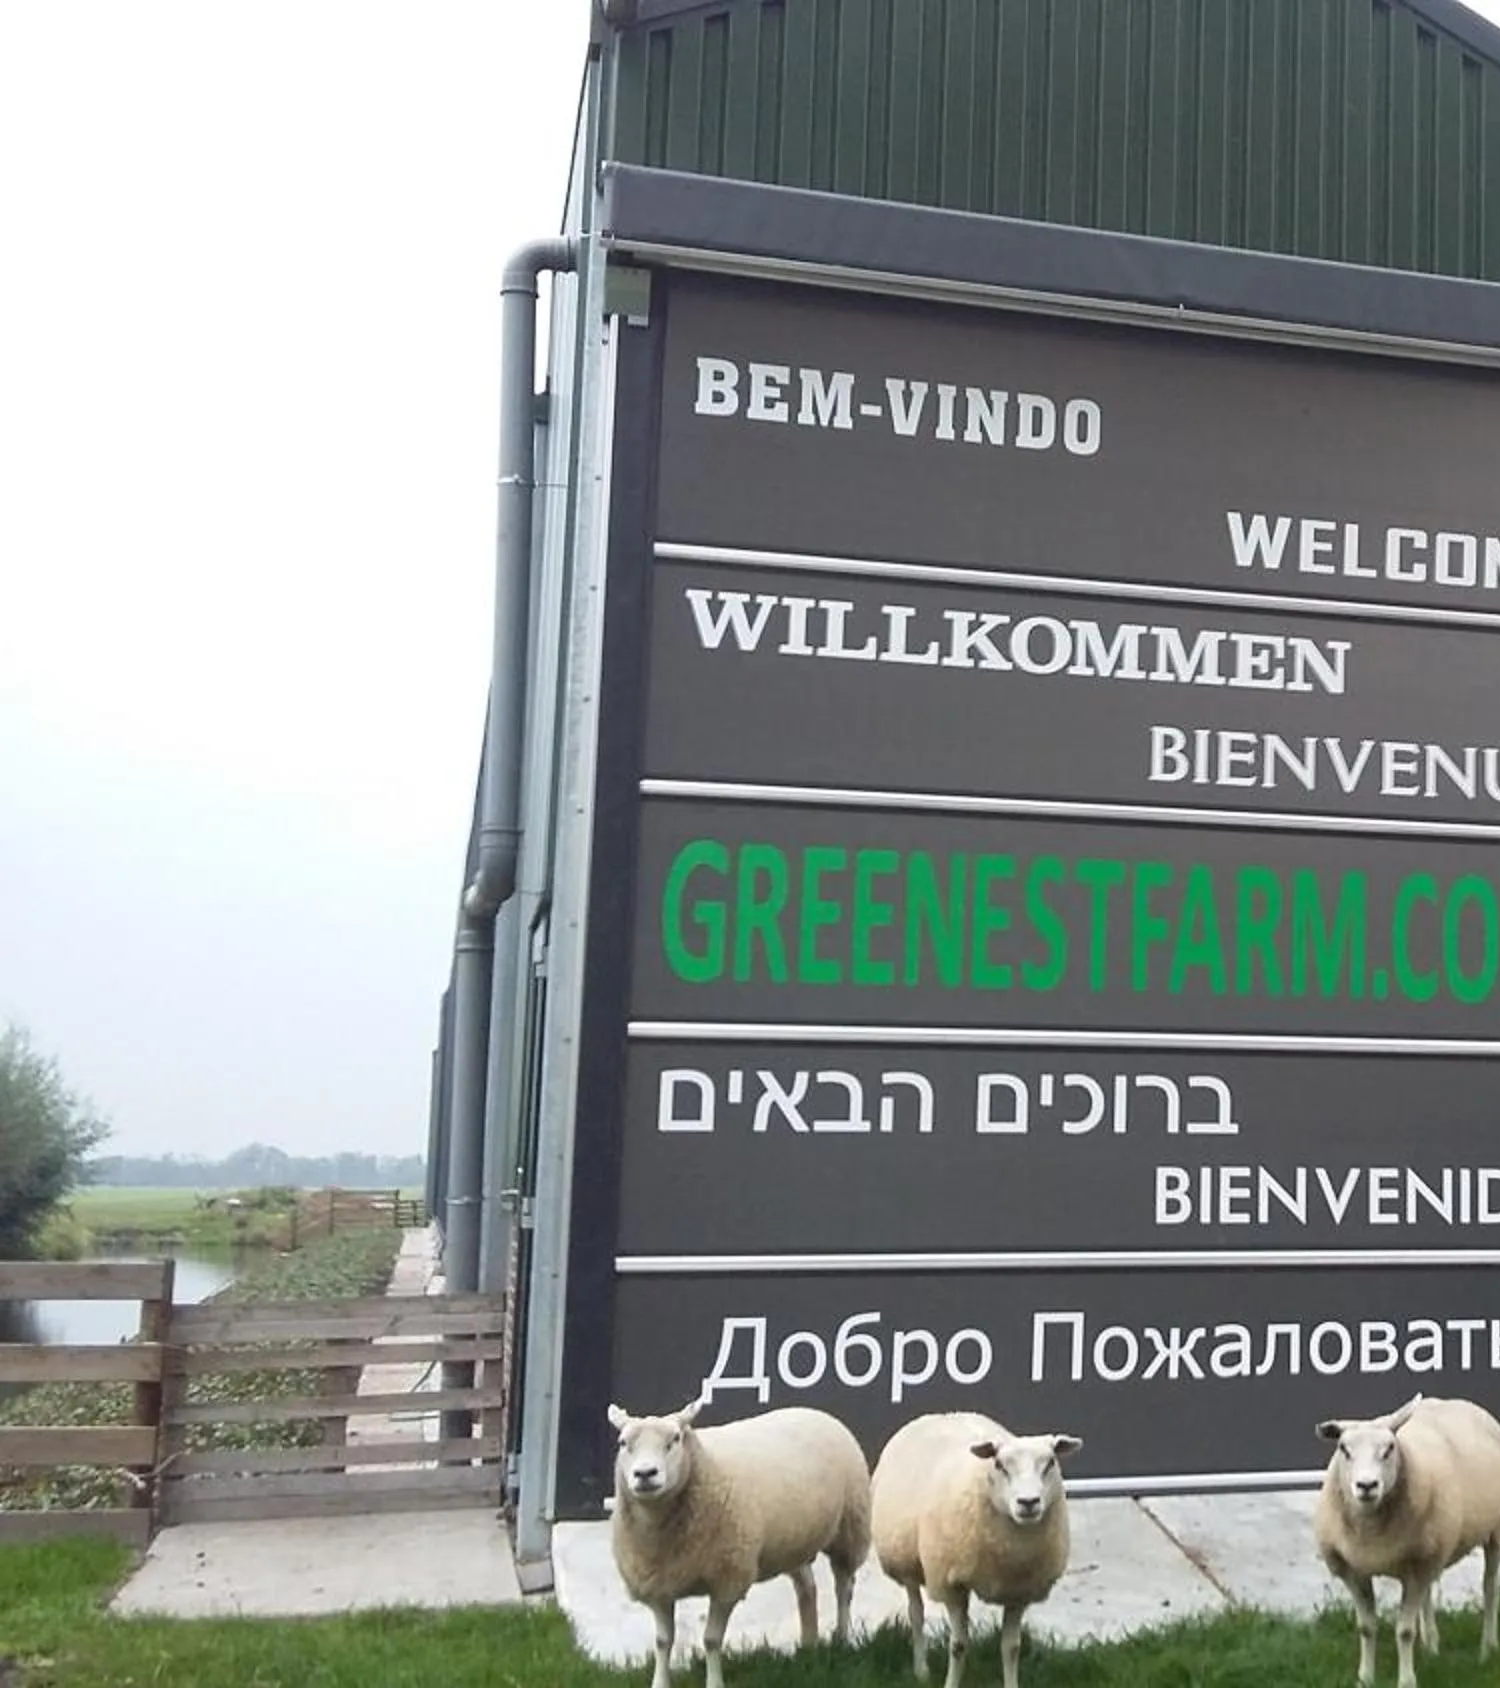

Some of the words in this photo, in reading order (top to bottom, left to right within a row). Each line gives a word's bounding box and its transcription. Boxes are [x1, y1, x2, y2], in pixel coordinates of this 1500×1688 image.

[694, 357, 1102, 456] BEM-VINDO
[686, 589, 1351, 695] WILLKOMMEN
[657, 1069, 934, 1134] הבאים
[975, 1073, 1240, 1136] ברוכים
[702, 1311, 993, 1404] Добро
